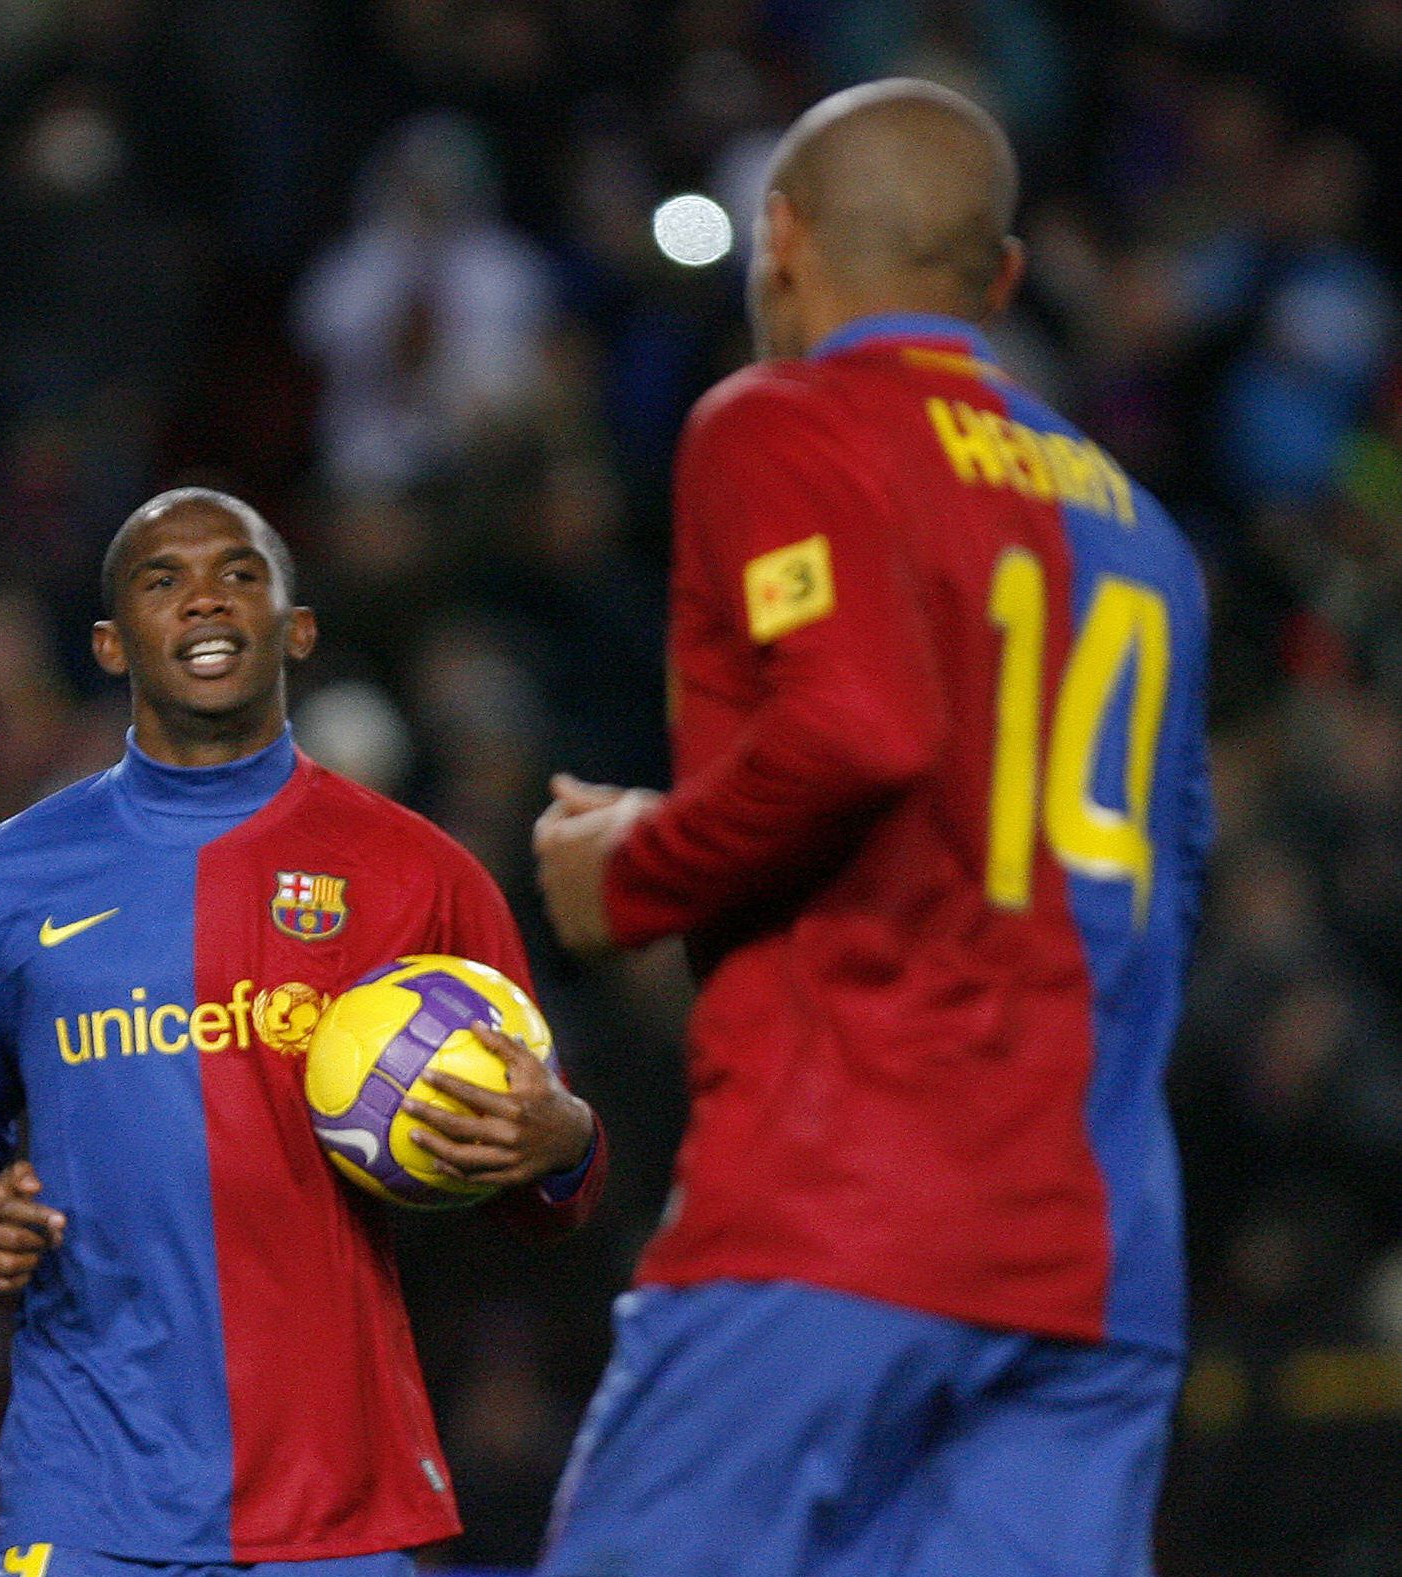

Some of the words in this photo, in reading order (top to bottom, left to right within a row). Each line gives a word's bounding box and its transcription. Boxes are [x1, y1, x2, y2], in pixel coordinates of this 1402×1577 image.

[925, 395, 1138, 530] HENRY
[984, 544, 1171, 940] 14
[55, 979, 254, 1066] unicef
